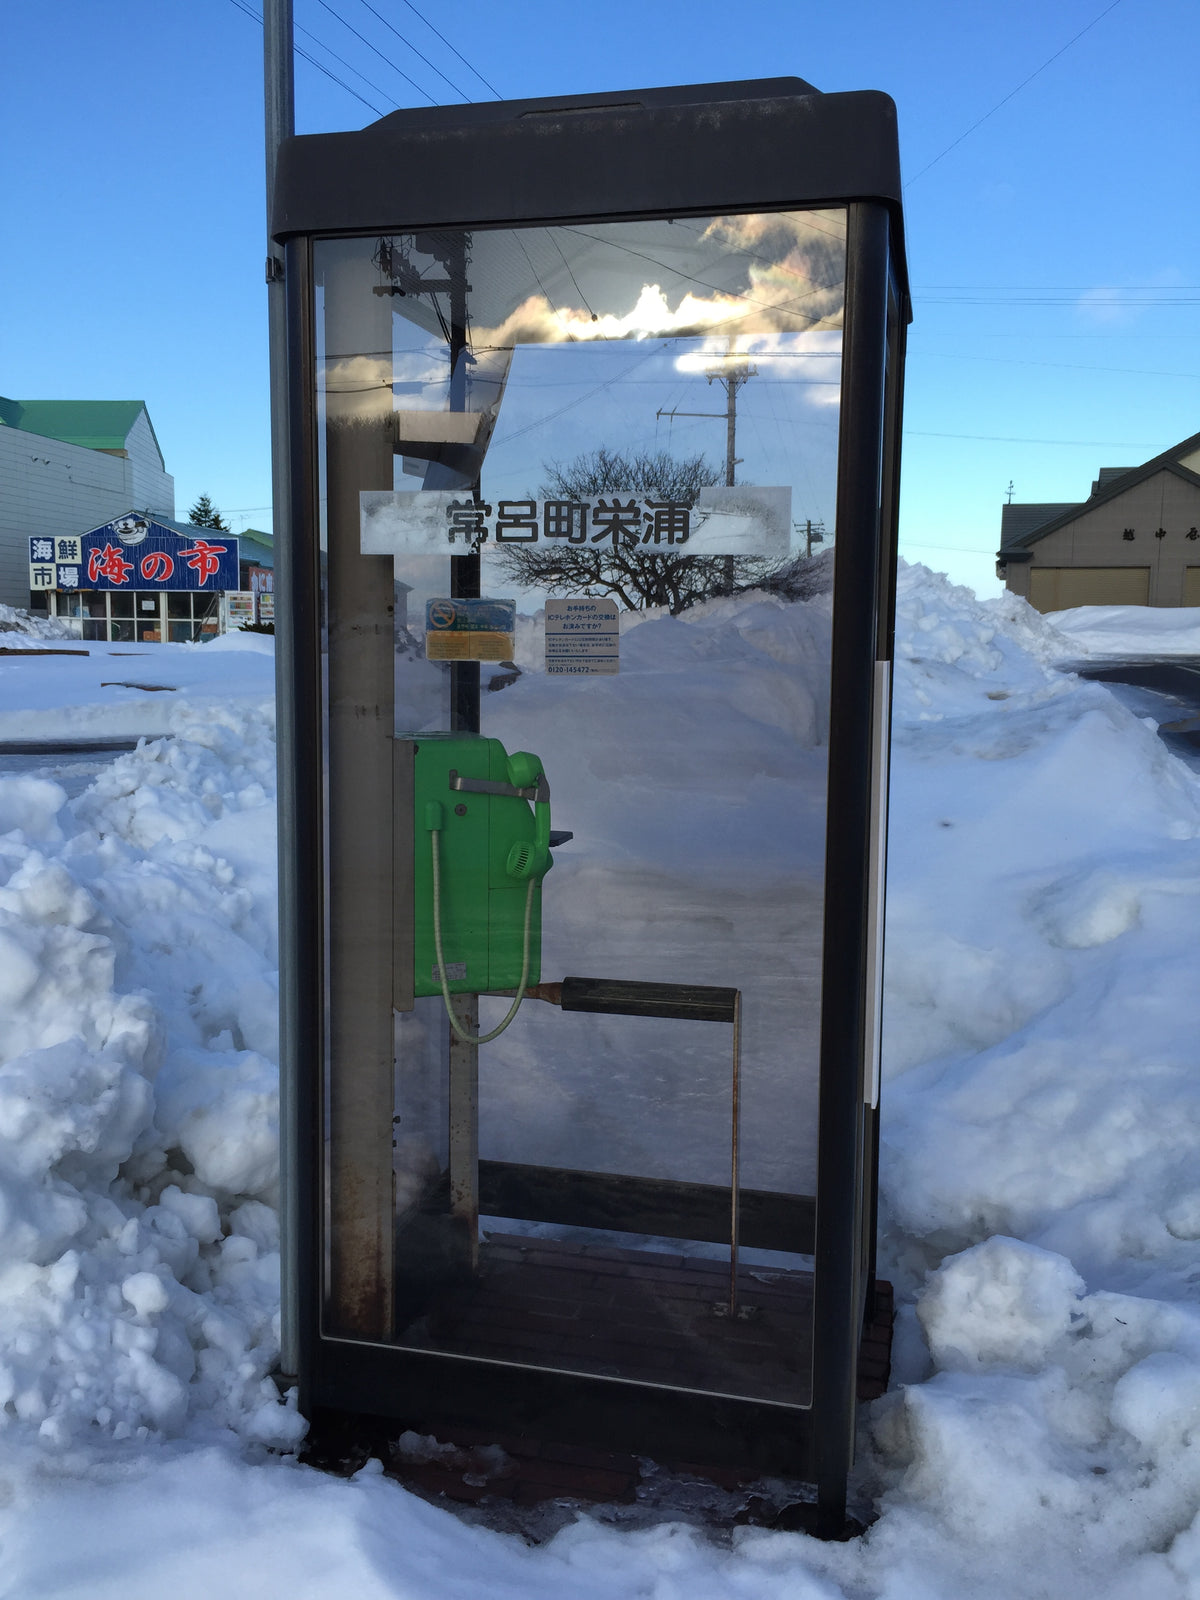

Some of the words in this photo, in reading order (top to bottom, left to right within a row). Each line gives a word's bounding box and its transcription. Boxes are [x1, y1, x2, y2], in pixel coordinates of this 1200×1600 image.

[446, 499, 694, 545] 常呂町栄浦
[32, 539, 78, 561] 海鮮
[88, 540, 228, 587] 海の市
[33, 566, 80, 588] 市場
